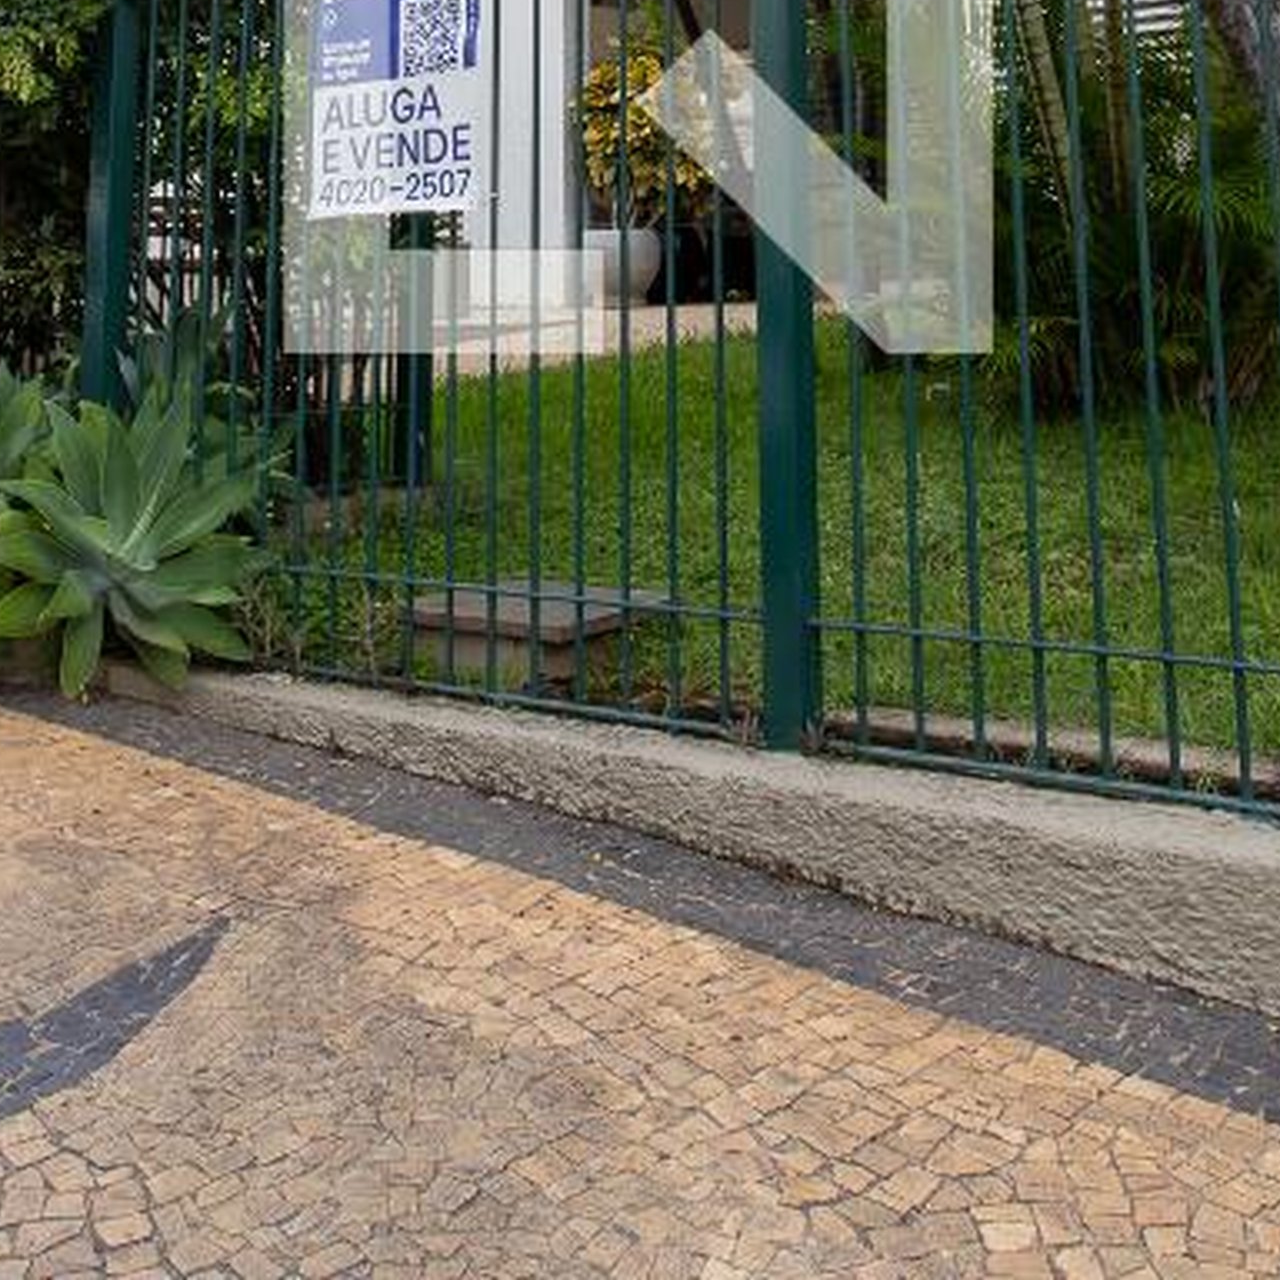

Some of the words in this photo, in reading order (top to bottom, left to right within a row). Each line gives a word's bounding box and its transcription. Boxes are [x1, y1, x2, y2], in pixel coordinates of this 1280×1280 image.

[323, 84, 442, 132] ALUGA
[323, 139, 341, 174] E
[349, 124, 472, 170] VENDE
[320, 168, 472, 207] 4020-2507
